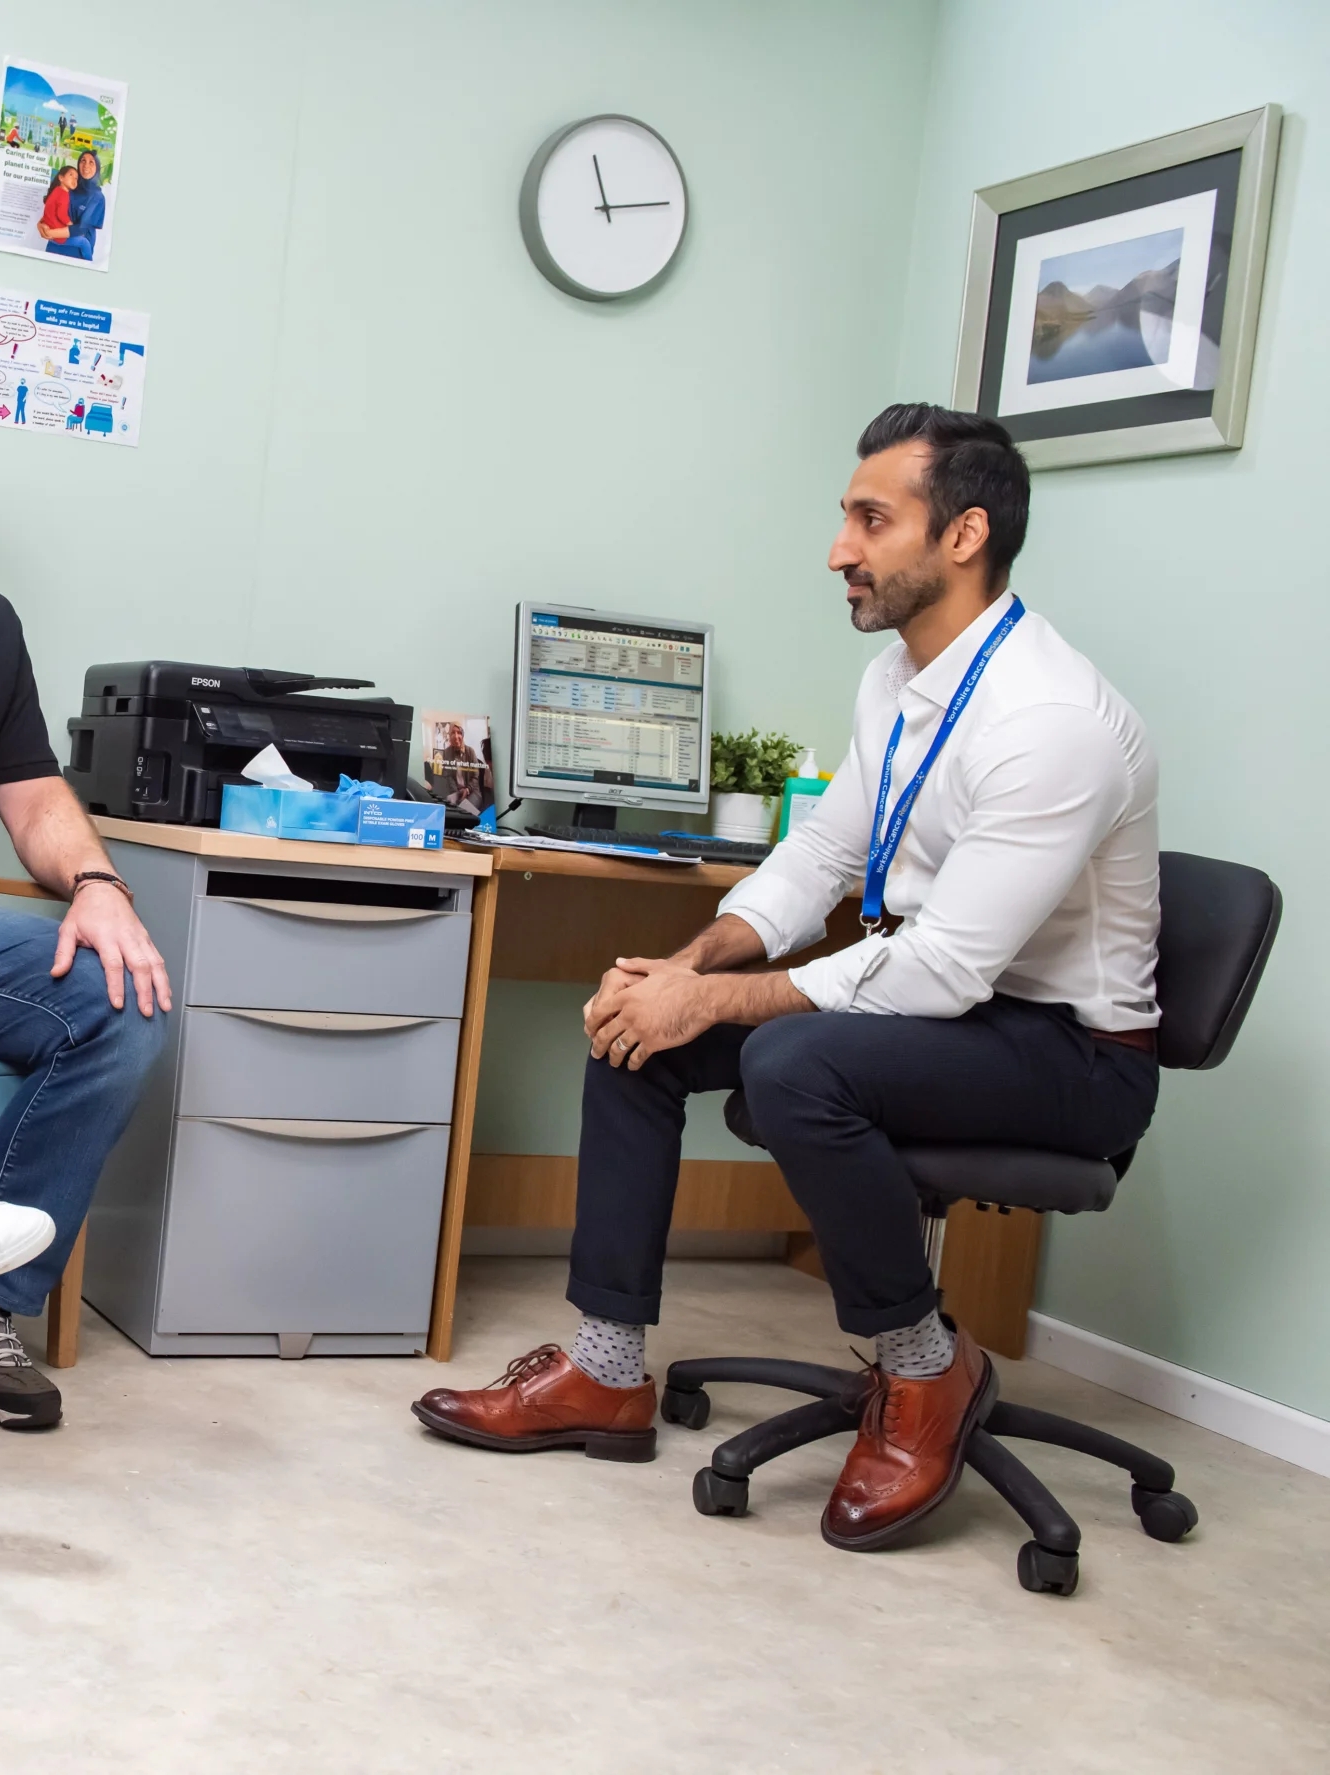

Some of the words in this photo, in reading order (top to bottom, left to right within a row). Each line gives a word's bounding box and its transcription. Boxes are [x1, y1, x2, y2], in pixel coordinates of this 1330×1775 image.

[6, 149, 25, 159] Caring
[4, 160, 23, 168] planet
[32, 166, 50, 175] caring
[24, 175, 48, 185] patients
[40, 304, 57, 314] Keeping
[81, 312, 106, 320] Coronavirus
[83, 322, 99, 330] hospital
[191, 677, 221, 688] EPSON
[947, 686, 970, 723] Yorkshire
[967, 658, 986, 686] Cancer
[983, 626, 1009, 658] Research
[884, 746, 895, 783] Yorkshire
[879, 783, 888, 812] Cancer
[875, 813, 884, 848] Research
[876, 843, 893, 874] Yorkshire
[888, 816, 902, 843] Cancer
[898, 784, 918, 817] Research
